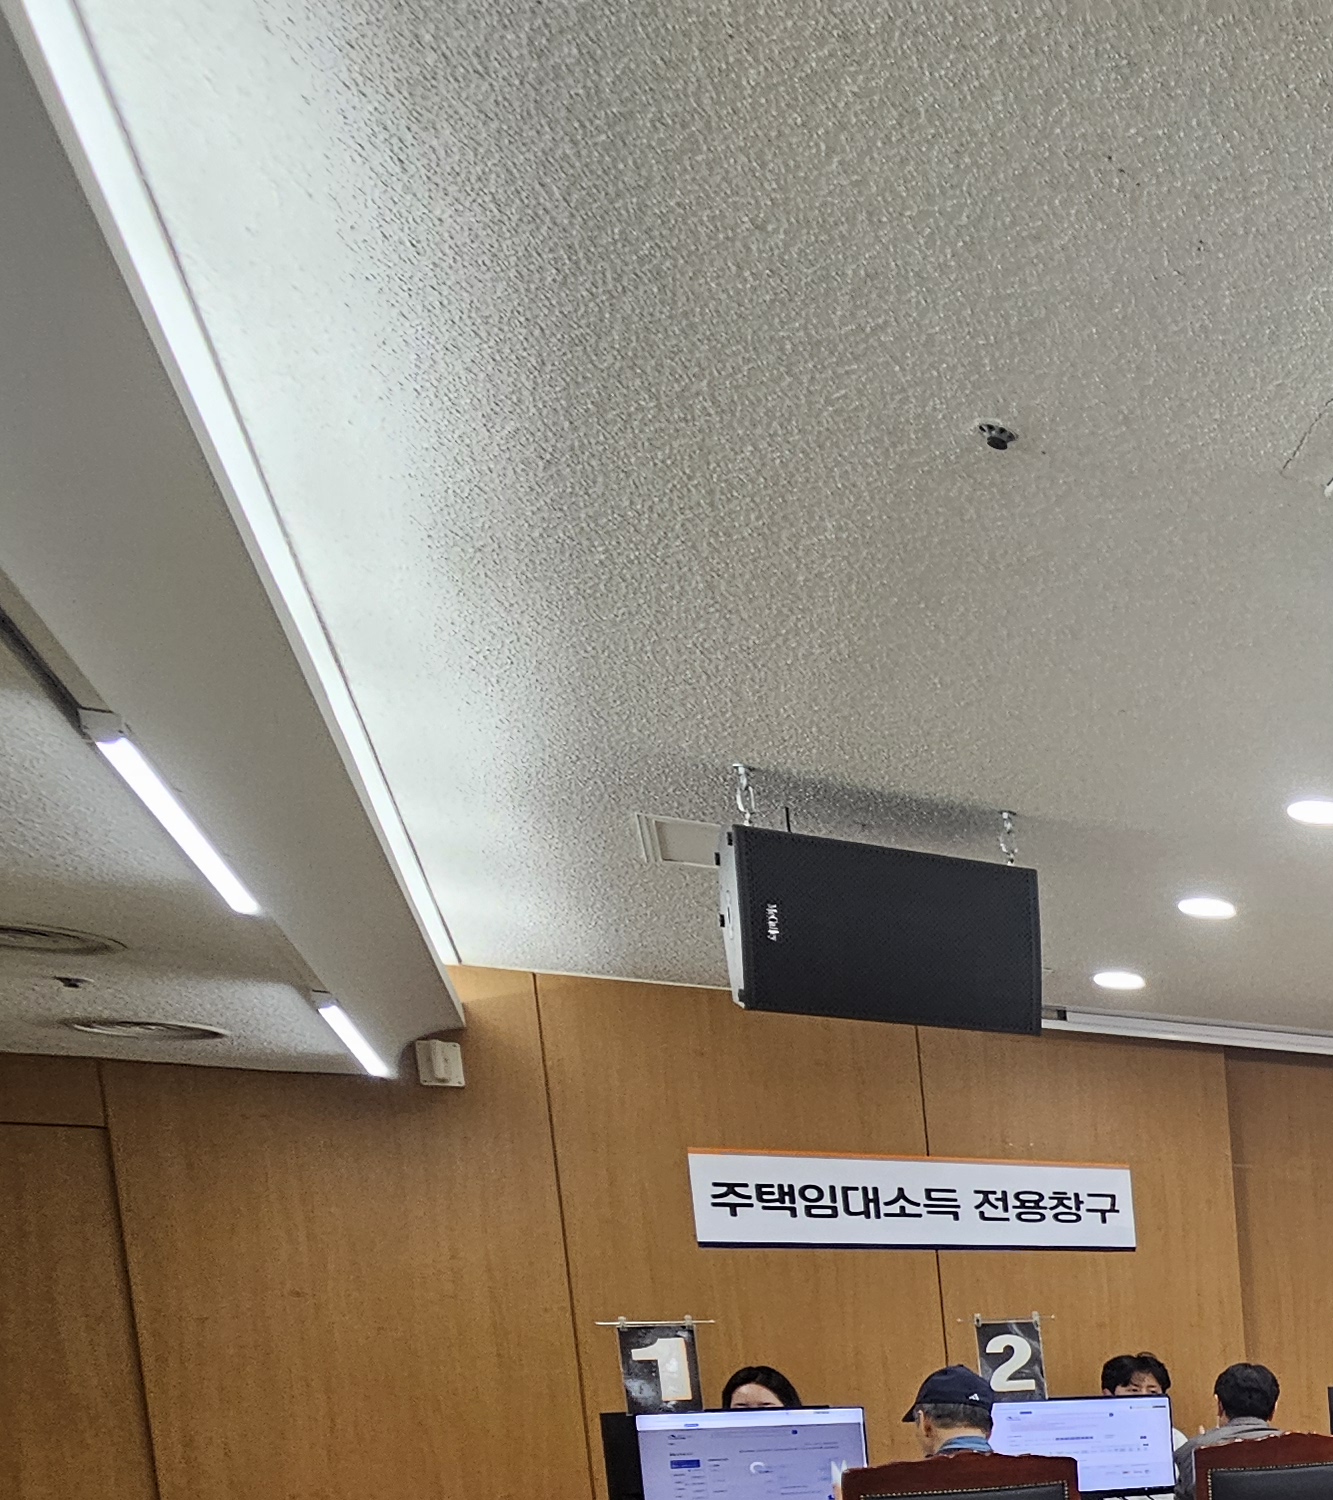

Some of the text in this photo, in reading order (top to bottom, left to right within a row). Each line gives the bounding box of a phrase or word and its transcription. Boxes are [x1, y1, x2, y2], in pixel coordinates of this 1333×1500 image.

[709, 1181, 1121, 1224] 주택임대소득 전용창구
[631, 1336, 692, 1402] 1
[985, 1334, 1036, 1392] 2
